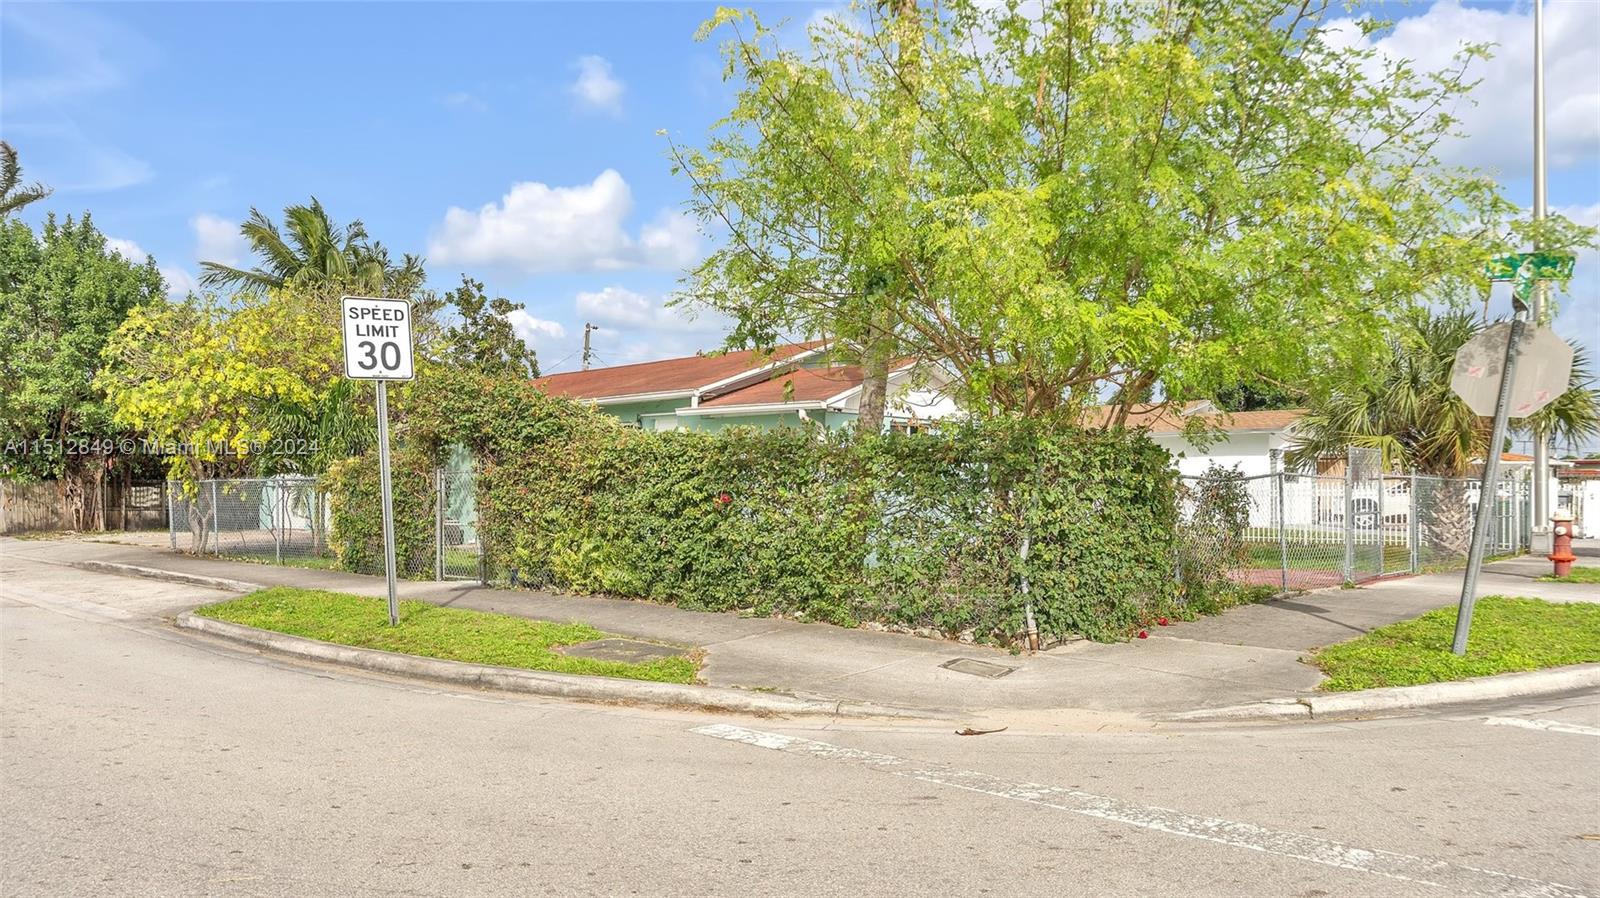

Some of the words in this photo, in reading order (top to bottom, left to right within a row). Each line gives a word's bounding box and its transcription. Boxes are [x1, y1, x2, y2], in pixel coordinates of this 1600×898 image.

[349, 307, 404, 321] SPEED
[356, 324, 399, 338] LIMIT
[358, 341, 401, 371] 30
